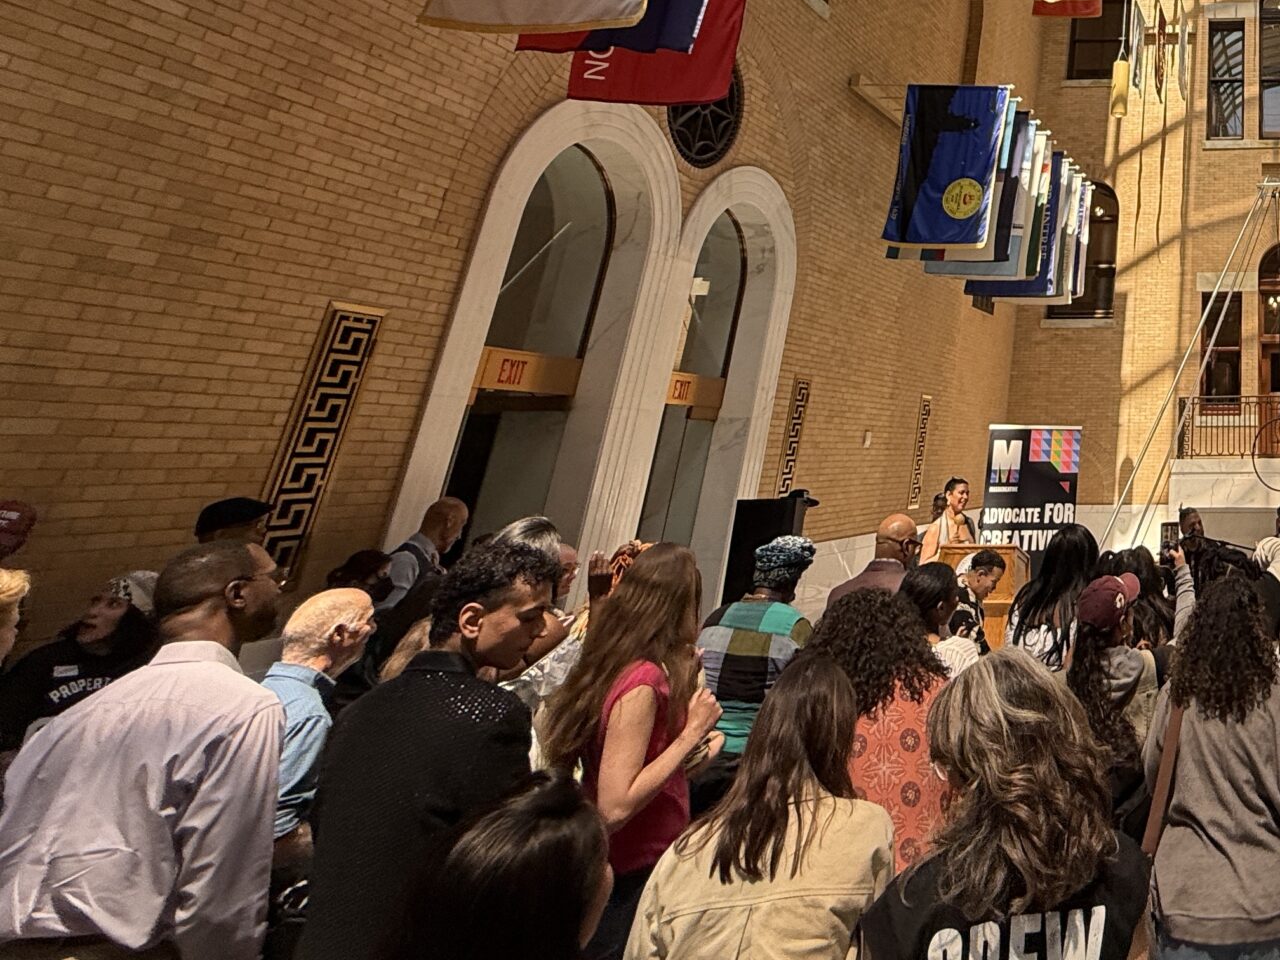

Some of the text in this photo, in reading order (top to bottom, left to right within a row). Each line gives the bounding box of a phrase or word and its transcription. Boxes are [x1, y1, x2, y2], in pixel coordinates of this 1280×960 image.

[497, 358, 528, 386] EXIT
[672, 379, 692, 401] EXIT
[983, 503, 1075, 524] ADVOCATE FOR
[980, 530, 1060, 552] CREATIVI
